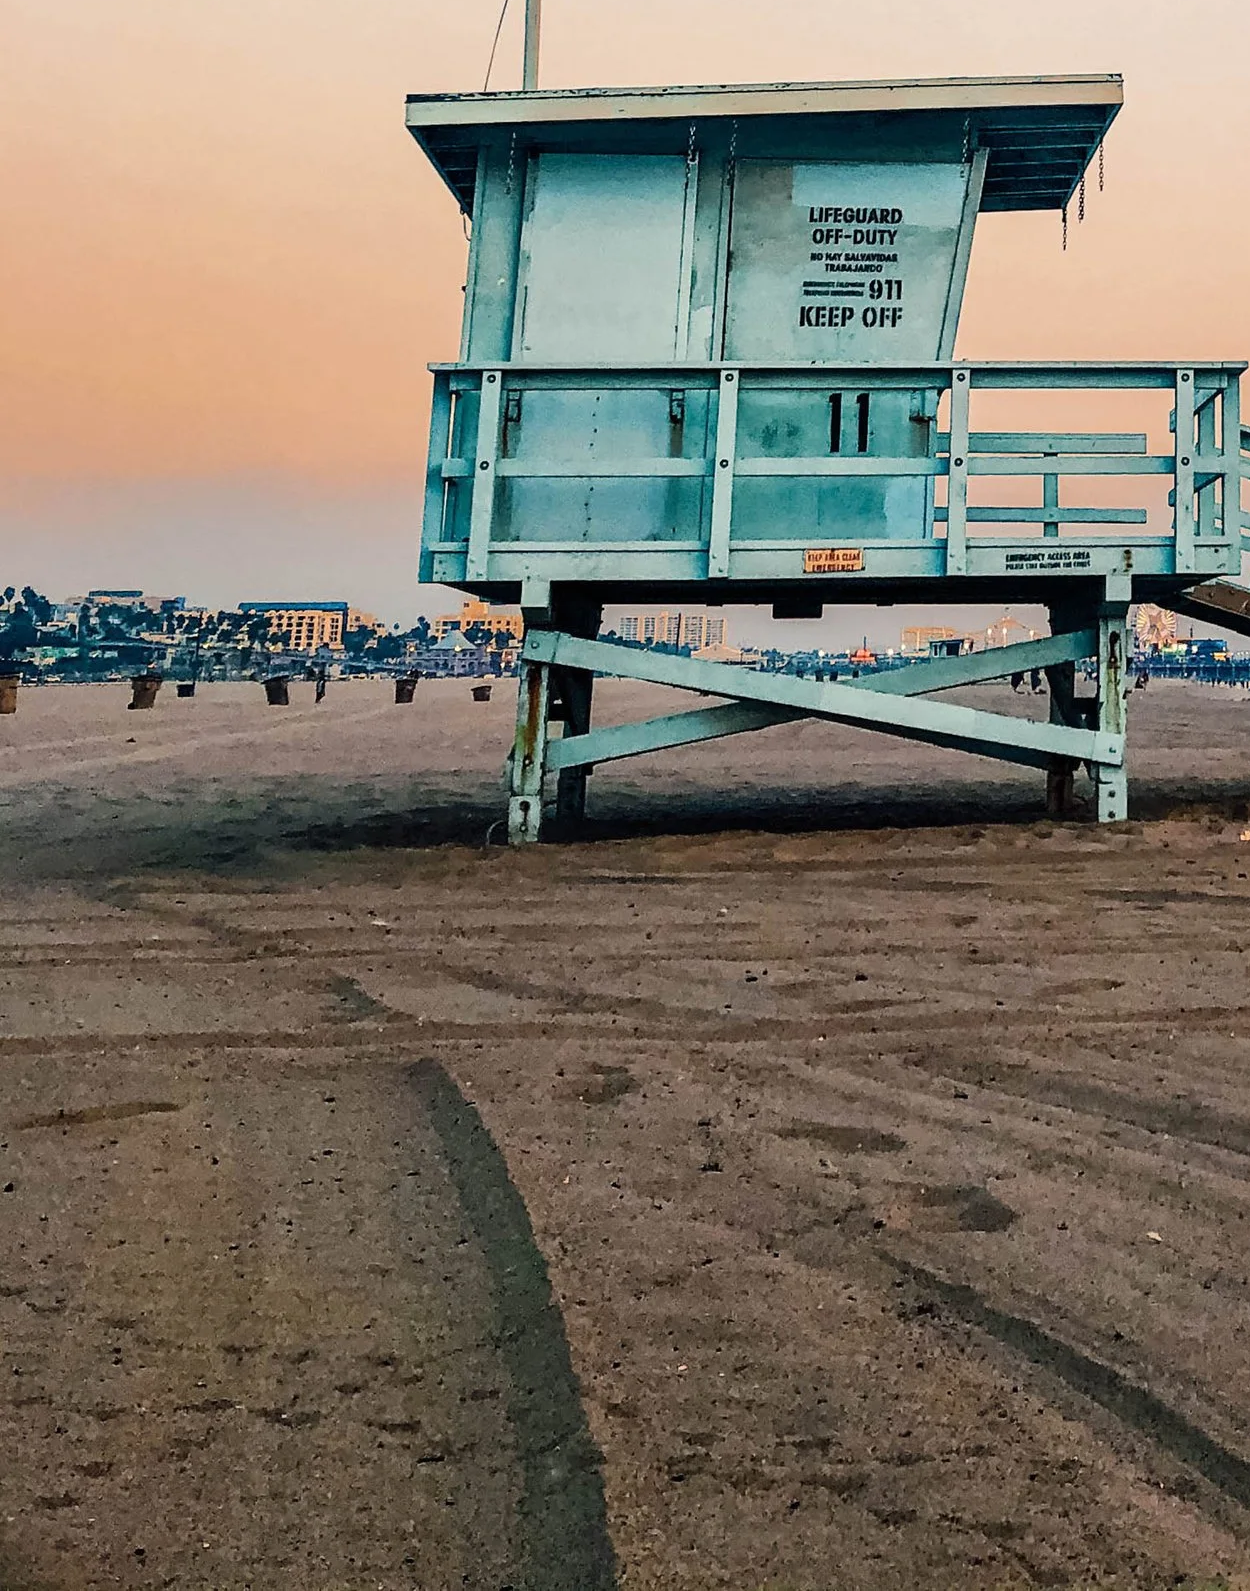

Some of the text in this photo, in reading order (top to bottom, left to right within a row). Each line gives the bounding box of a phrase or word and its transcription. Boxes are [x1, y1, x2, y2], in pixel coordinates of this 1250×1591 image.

[809, 207, 903, 224] LIFEGUARD
[812, 229, 898, 245] OFF-DUTY
[869, 279, 903, 300] 911
[800, 306, 903, 328] KEEP OFF
[829, 393, 870, 453] 11
